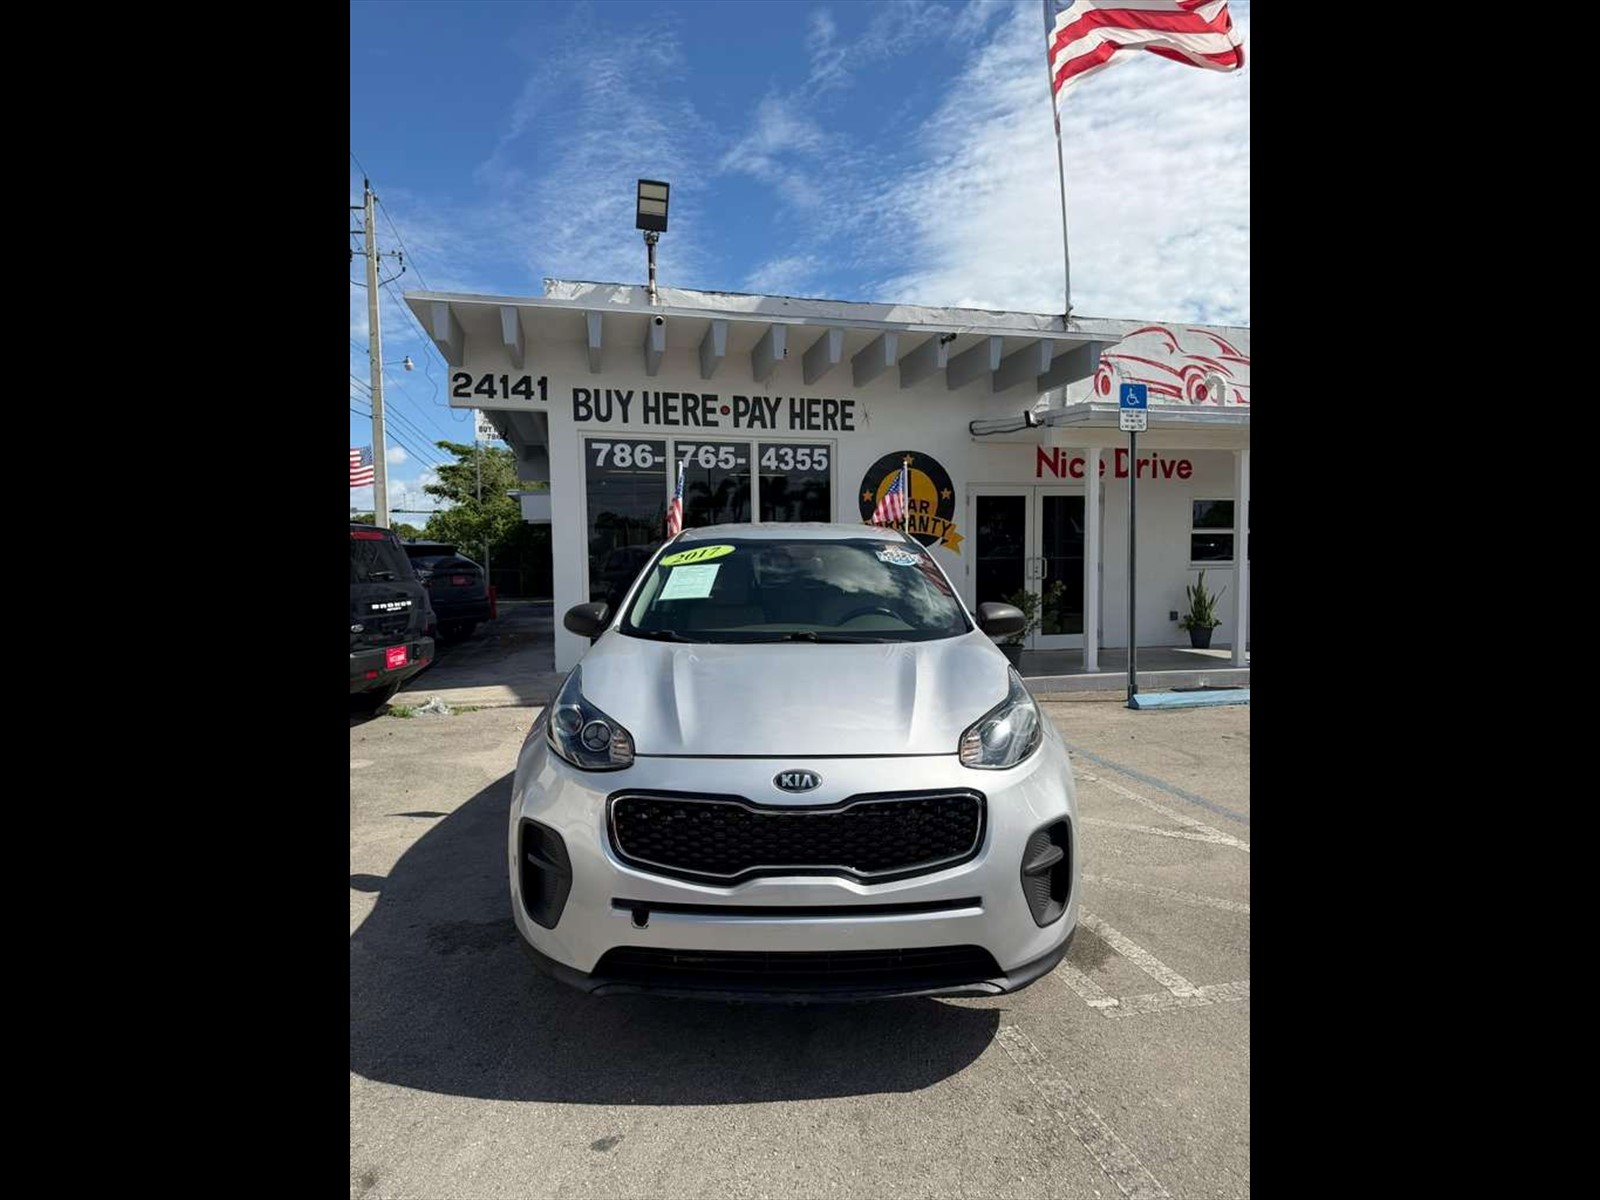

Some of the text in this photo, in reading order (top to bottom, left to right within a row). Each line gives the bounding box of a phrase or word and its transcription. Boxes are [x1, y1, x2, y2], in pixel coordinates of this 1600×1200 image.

[453, 372, 547, 401] 24141
[572, 388, 855, 431] BUY HERE PAY HERE
[591, 443, 828, 471] 786- 765- 4355
[1115, 448, 1193, 479] Drive
[672, 546, 721, 563] 2017
[781, 774, 814, 787] KIA
